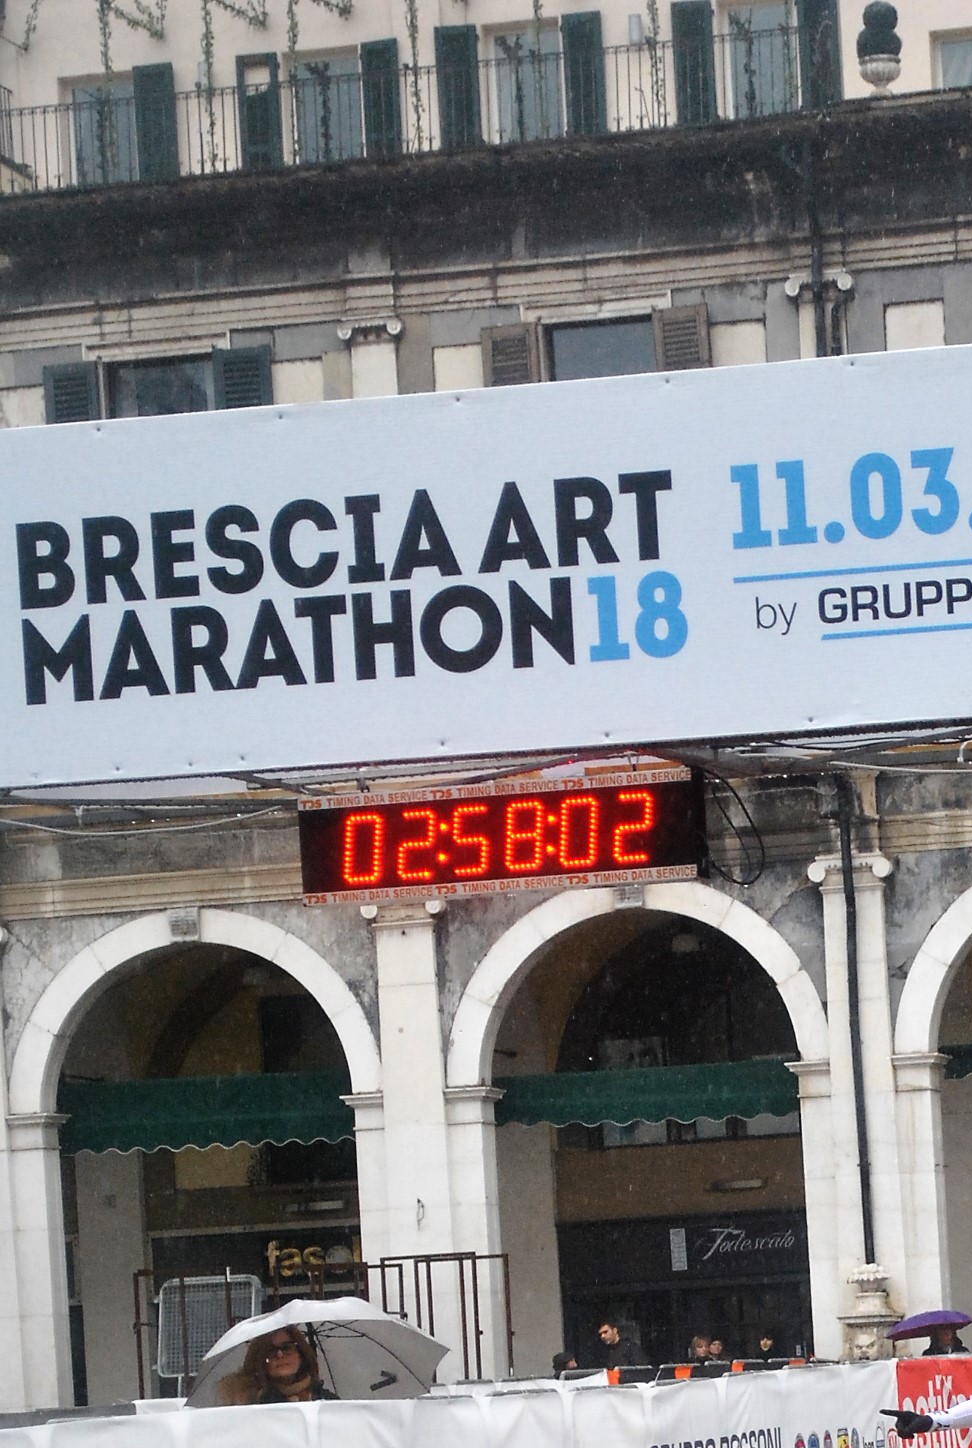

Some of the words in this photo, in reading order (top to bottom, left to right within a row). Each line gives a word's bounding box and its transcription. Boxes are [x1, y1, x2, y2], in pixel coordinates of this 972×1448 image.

[16, 488, 462, 610] BRESCIA
[478, 469, 673, 574] ART
[755, 595, 798, 635] by
[343, 790, 655, 887] 02:58:02
